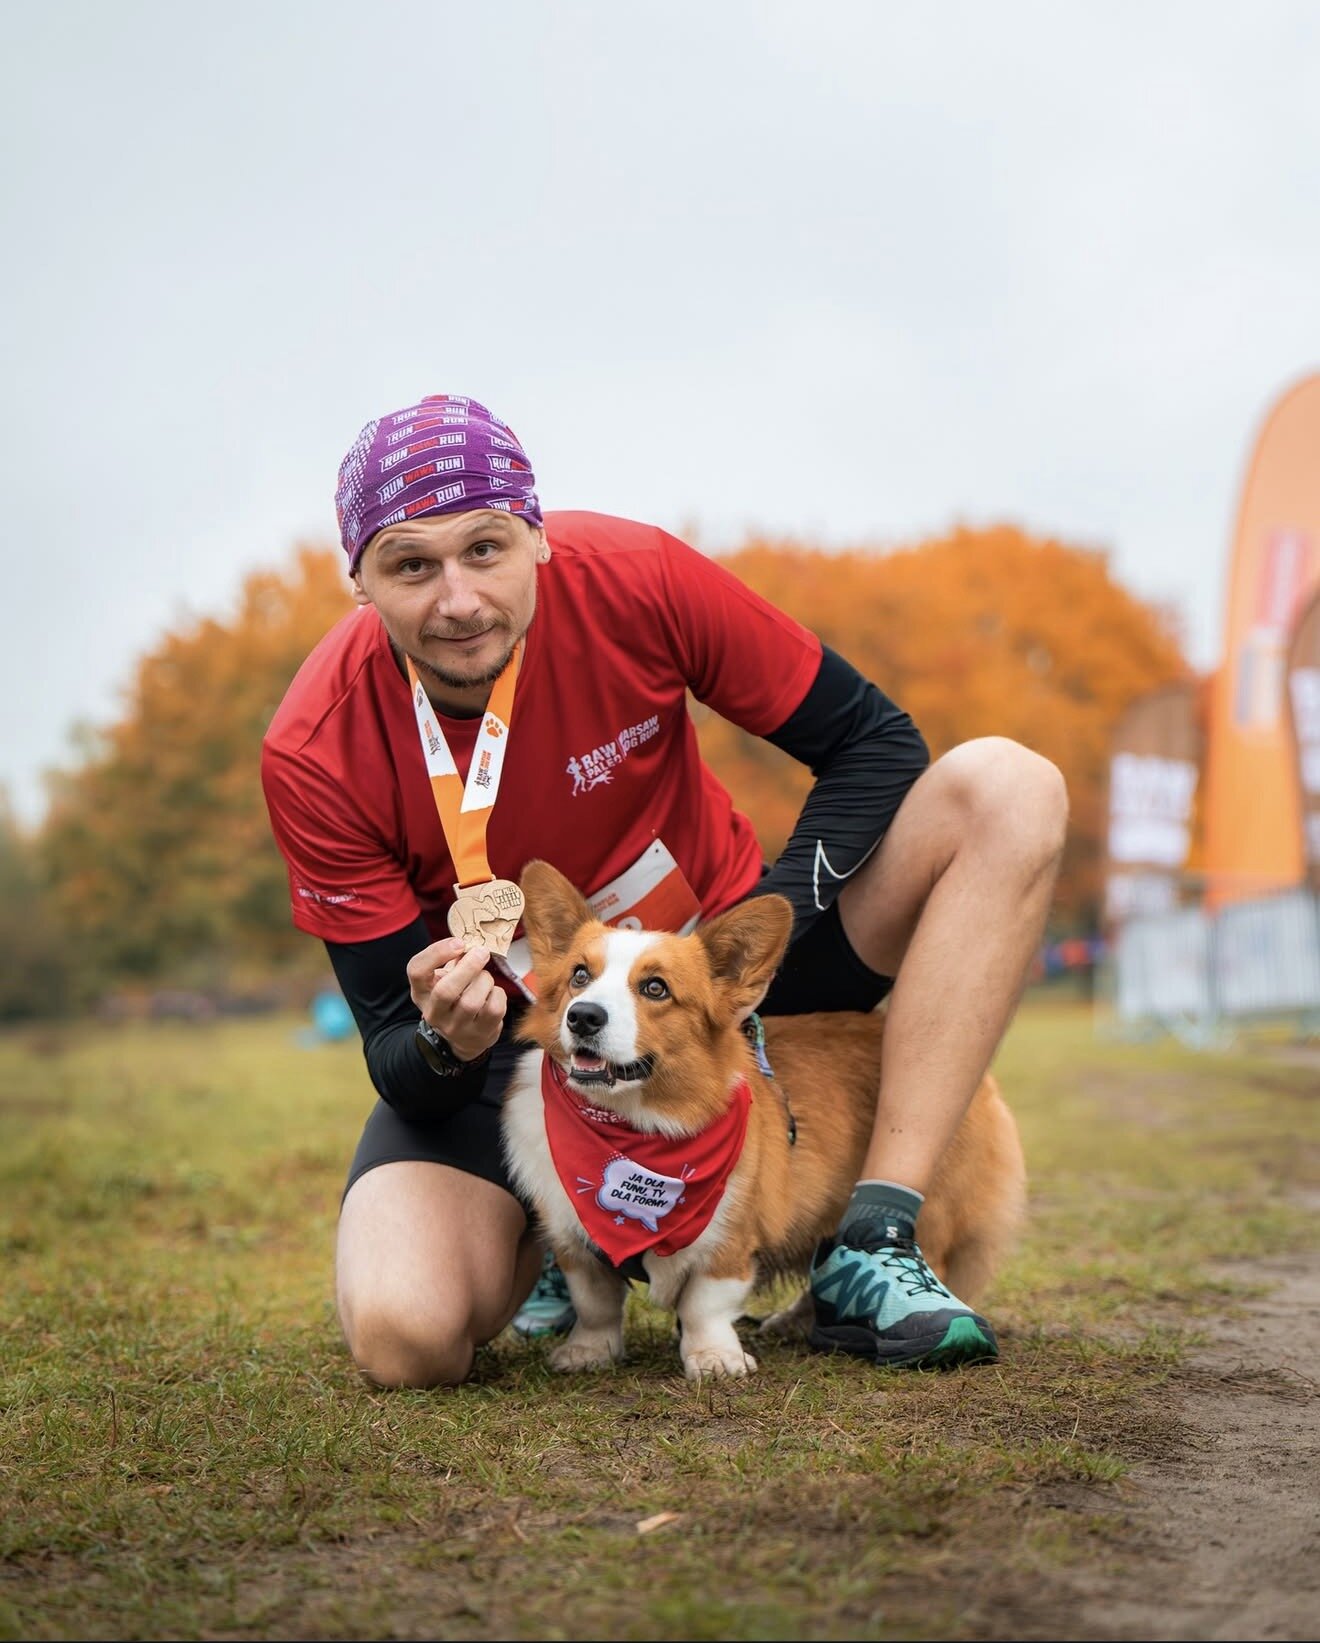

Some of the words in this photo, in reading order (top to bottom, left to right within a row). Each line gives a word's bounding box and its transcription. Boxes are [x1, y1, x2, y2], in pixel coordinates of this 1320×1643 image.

[391, 425, 413, 443] RUN
[385, 447, 408, 468] RUN
[440, 434, 463, 445] RUN
[382, 476, 405, 501] RUN
[436, 458, 461, 472] RUN
[436, 485, 462, 503] RUN
[639, 723, 660, 745] RUN
[580, 741, 617, 770] RAW
[620, 1181, 648, 1196] FUNU,
[652, 1189, 666, 1198] TY
[628, 1173, 643, 1184] JA
[644, 1178, 666, 1189] DLA
[610, 1189, 632, 1202] DLA
[632, 1195, 669, 1208] FORMY
[886, 1226, 898, 1238] S
